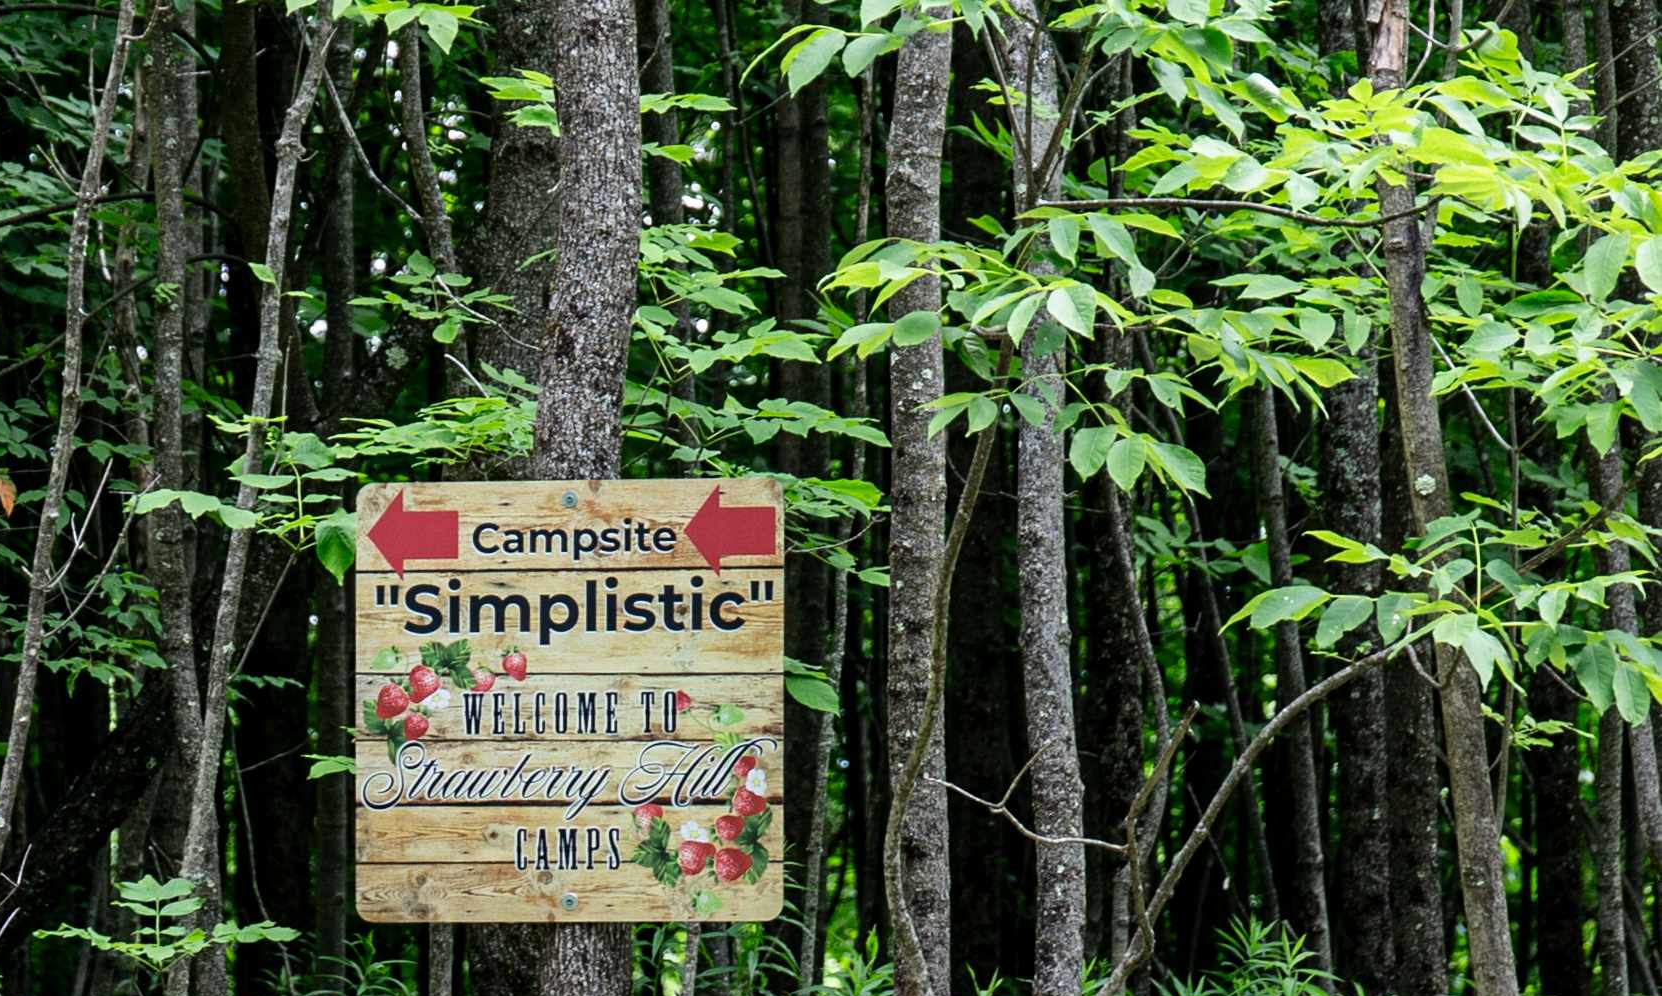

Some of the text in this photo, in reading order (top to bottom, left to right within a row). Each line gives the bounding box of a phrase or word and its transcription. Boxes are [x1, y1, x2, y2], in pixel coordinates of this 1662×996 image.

[472, 518, 678, 560] Campsite
[375, 575, 774, 645] "Simplistic"
[463, 690, 678, 735] WELCOME TO
[361, 736, 778, 820] Strawberry Hill
[516, 827, 622, 871] CAMPS
